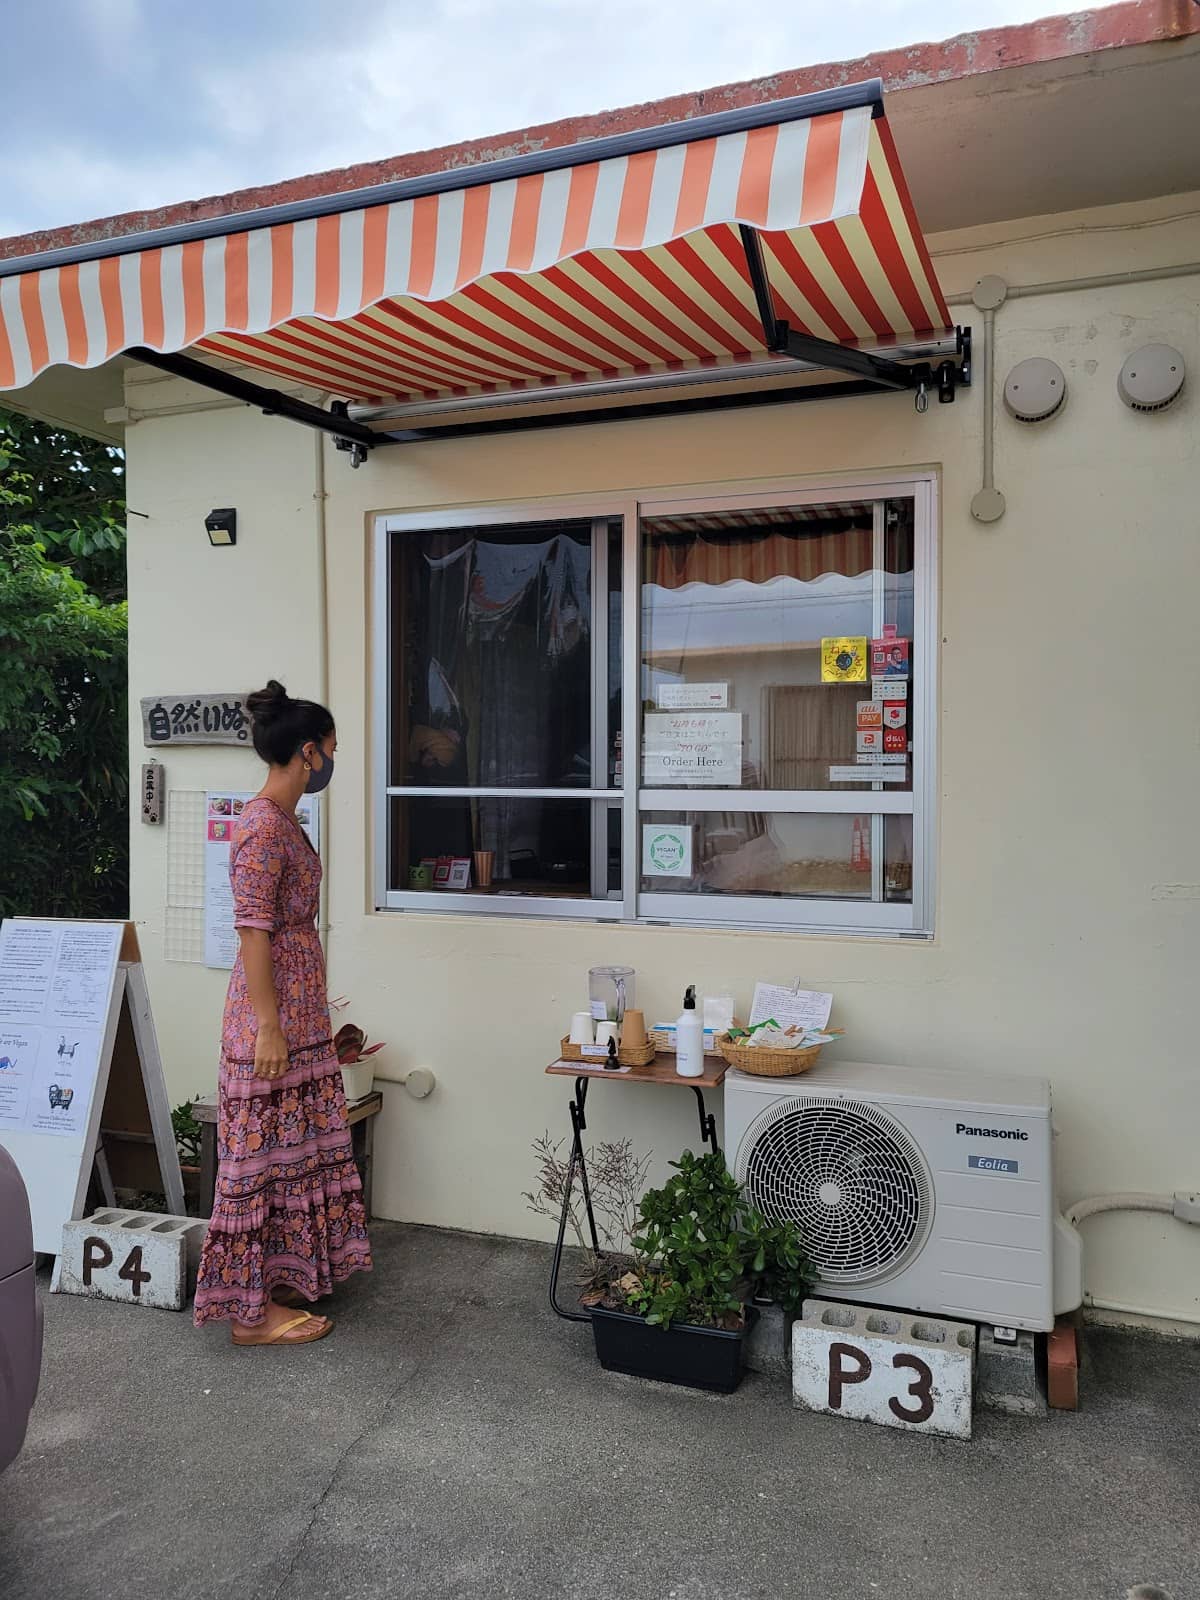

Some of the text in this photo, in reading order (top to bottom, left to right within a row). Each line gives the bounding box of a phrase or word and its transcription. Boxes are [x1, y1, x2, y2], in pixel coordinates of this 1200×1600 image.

[662, 756, 724, 767] Order Here
[956, 1123, 1029, 1141] Panasonic
[977, 1157, 1009, 1171] Eolia
